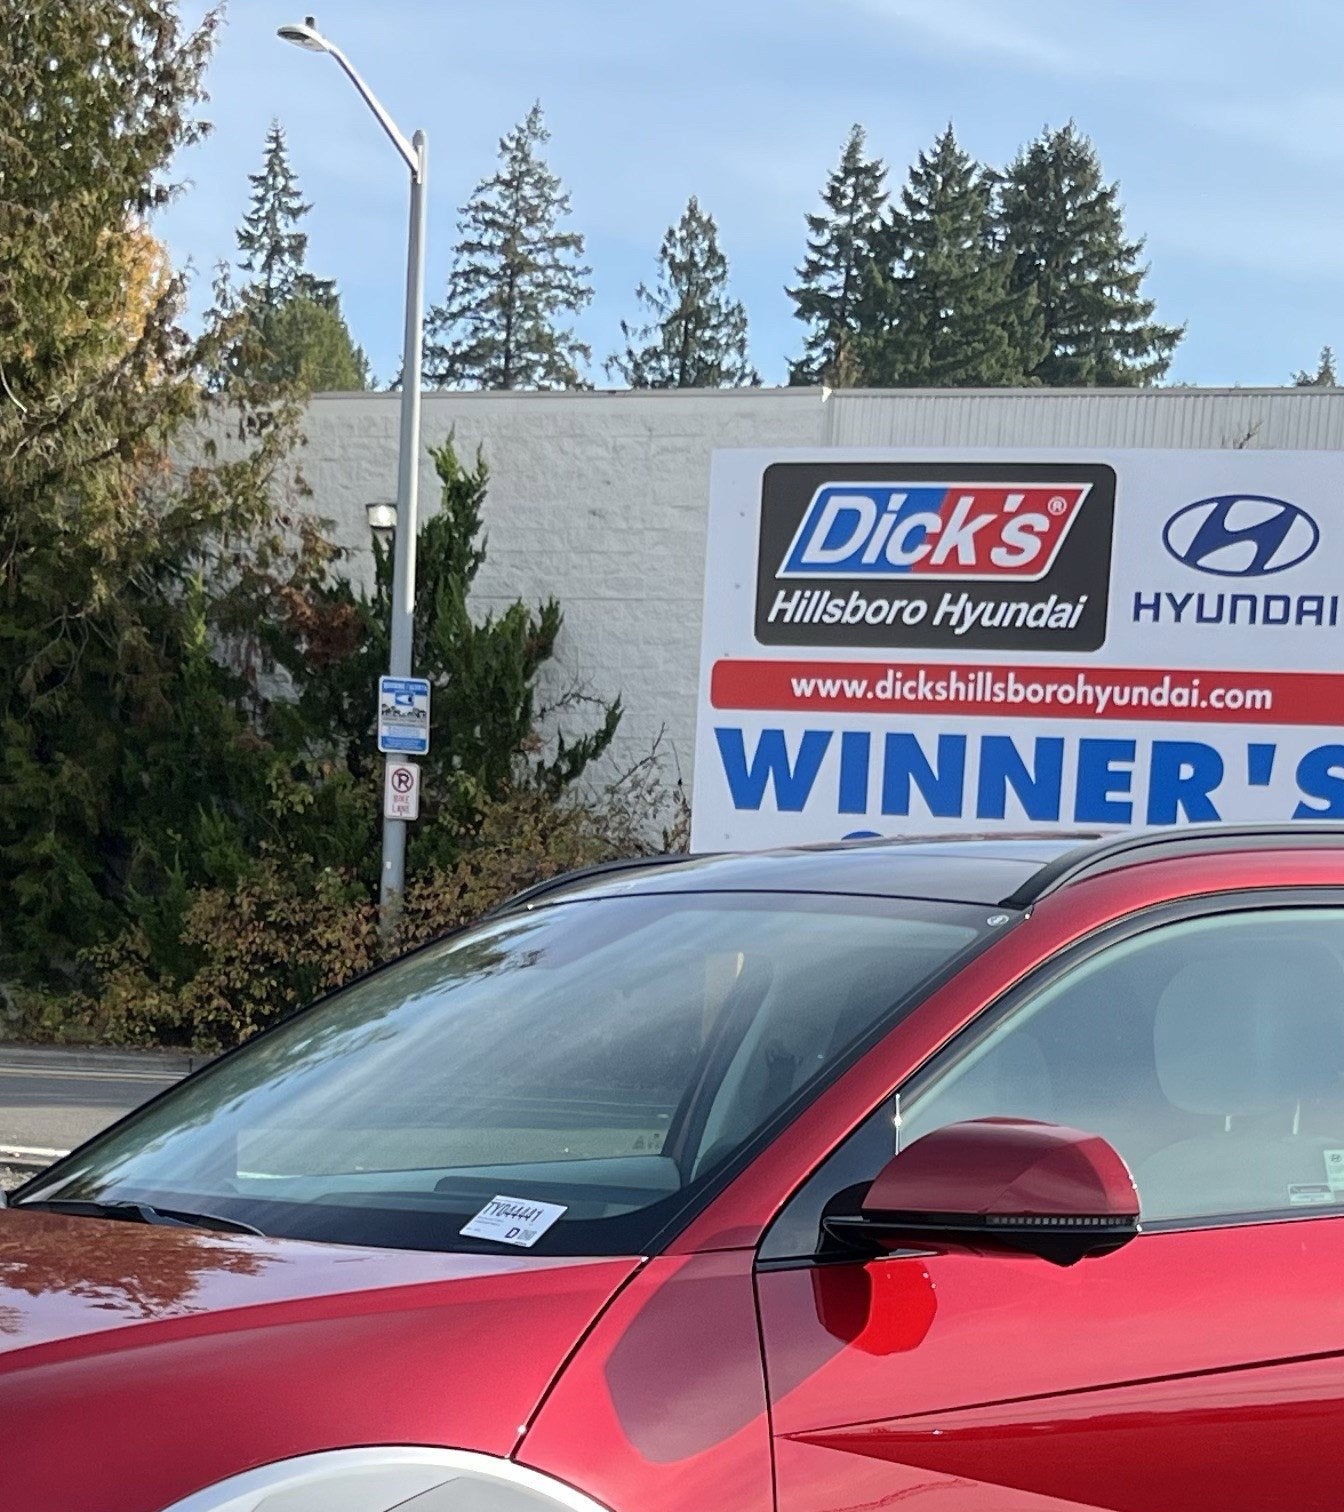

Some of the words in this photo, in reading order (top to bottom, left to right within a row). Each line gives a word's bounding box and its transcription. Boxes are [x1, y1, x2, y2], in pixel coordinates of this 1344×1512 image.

[801, 494, 1050, 567] Dick's
[767, 588, 928, 625] Hillsboro
[932, 592, 1087, 635] Hyundai
[1132, 591, 1339, 627] HYUNDAI
[790, 668, 1273, 714] www.dickshillsborohyundai.com
